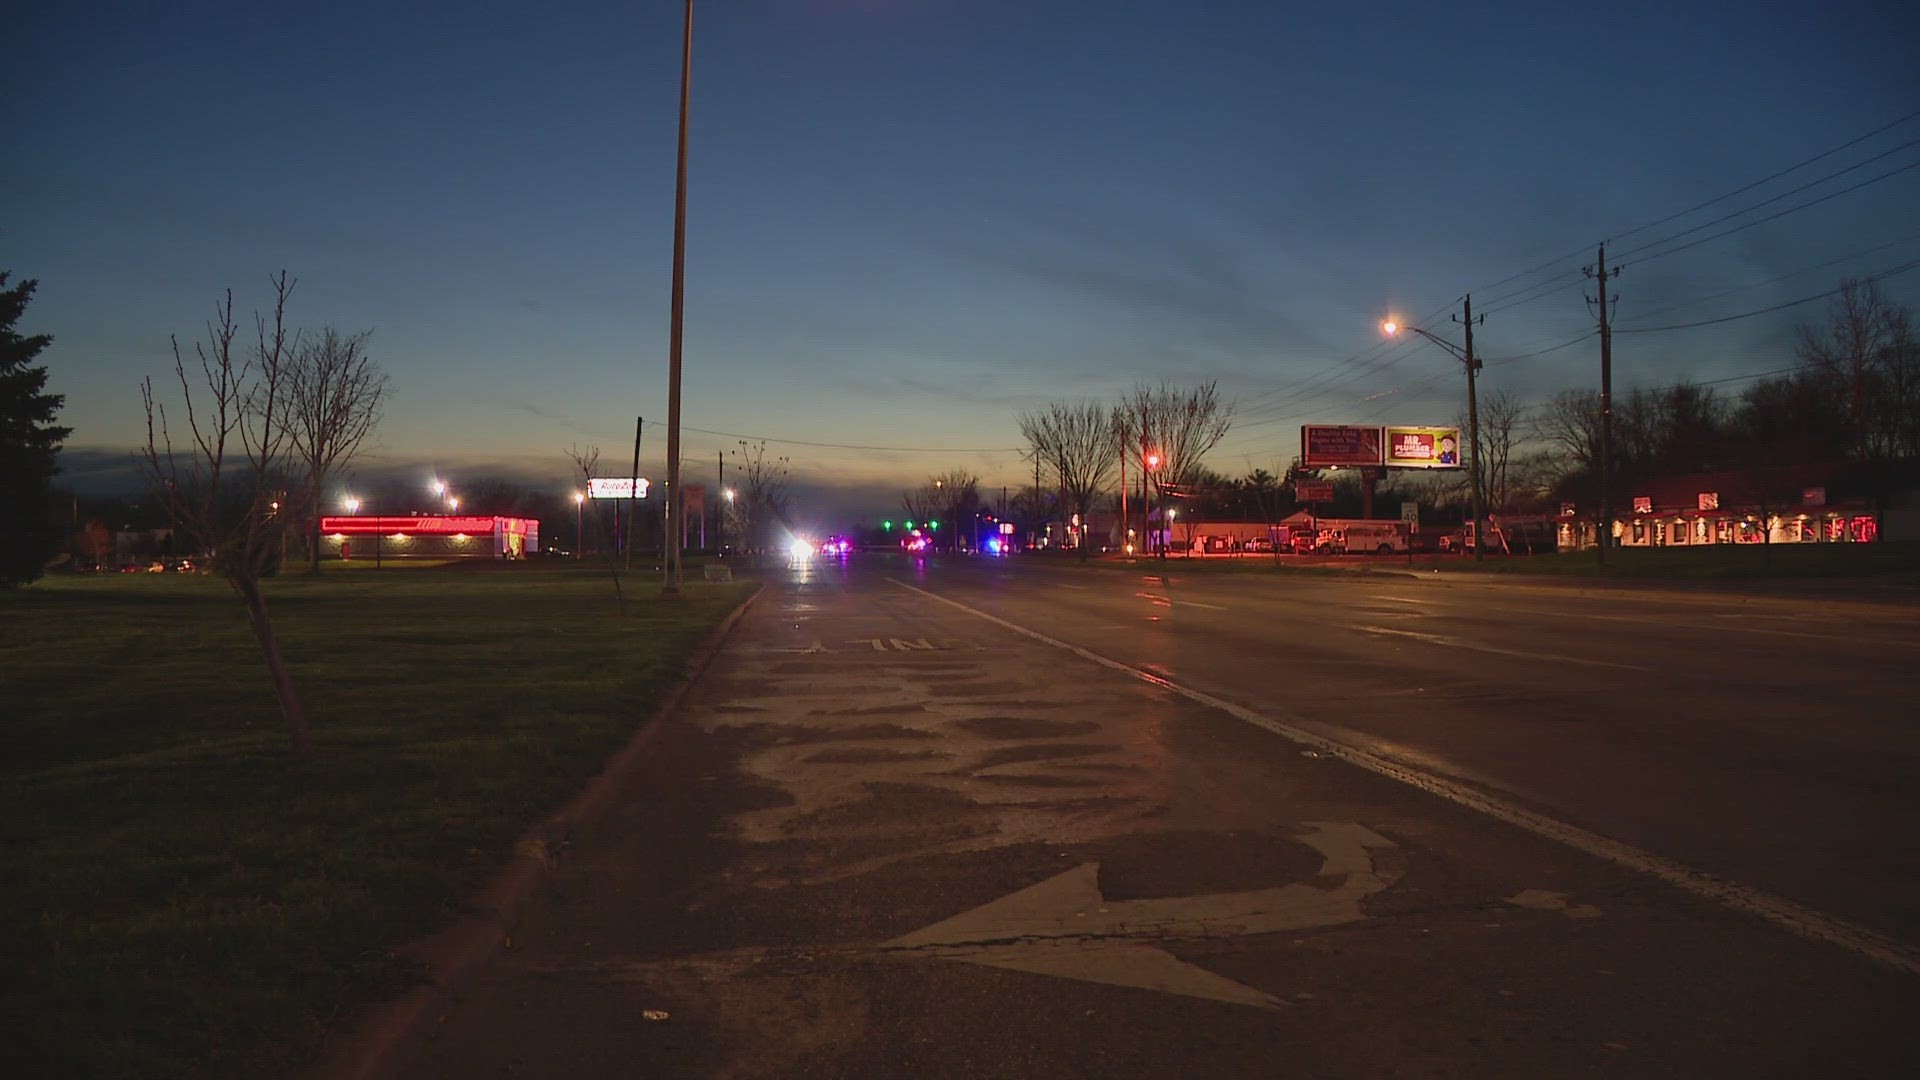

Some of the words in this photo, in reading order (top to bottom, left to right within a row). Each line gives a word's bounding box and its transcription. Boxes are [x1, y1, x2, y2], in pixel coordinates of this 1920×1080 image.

[1395, 444, 1430, 453] PLUMBER
[601, 482, 641, 490] AutoZo
[1403, 513, 1417, 522] 40
